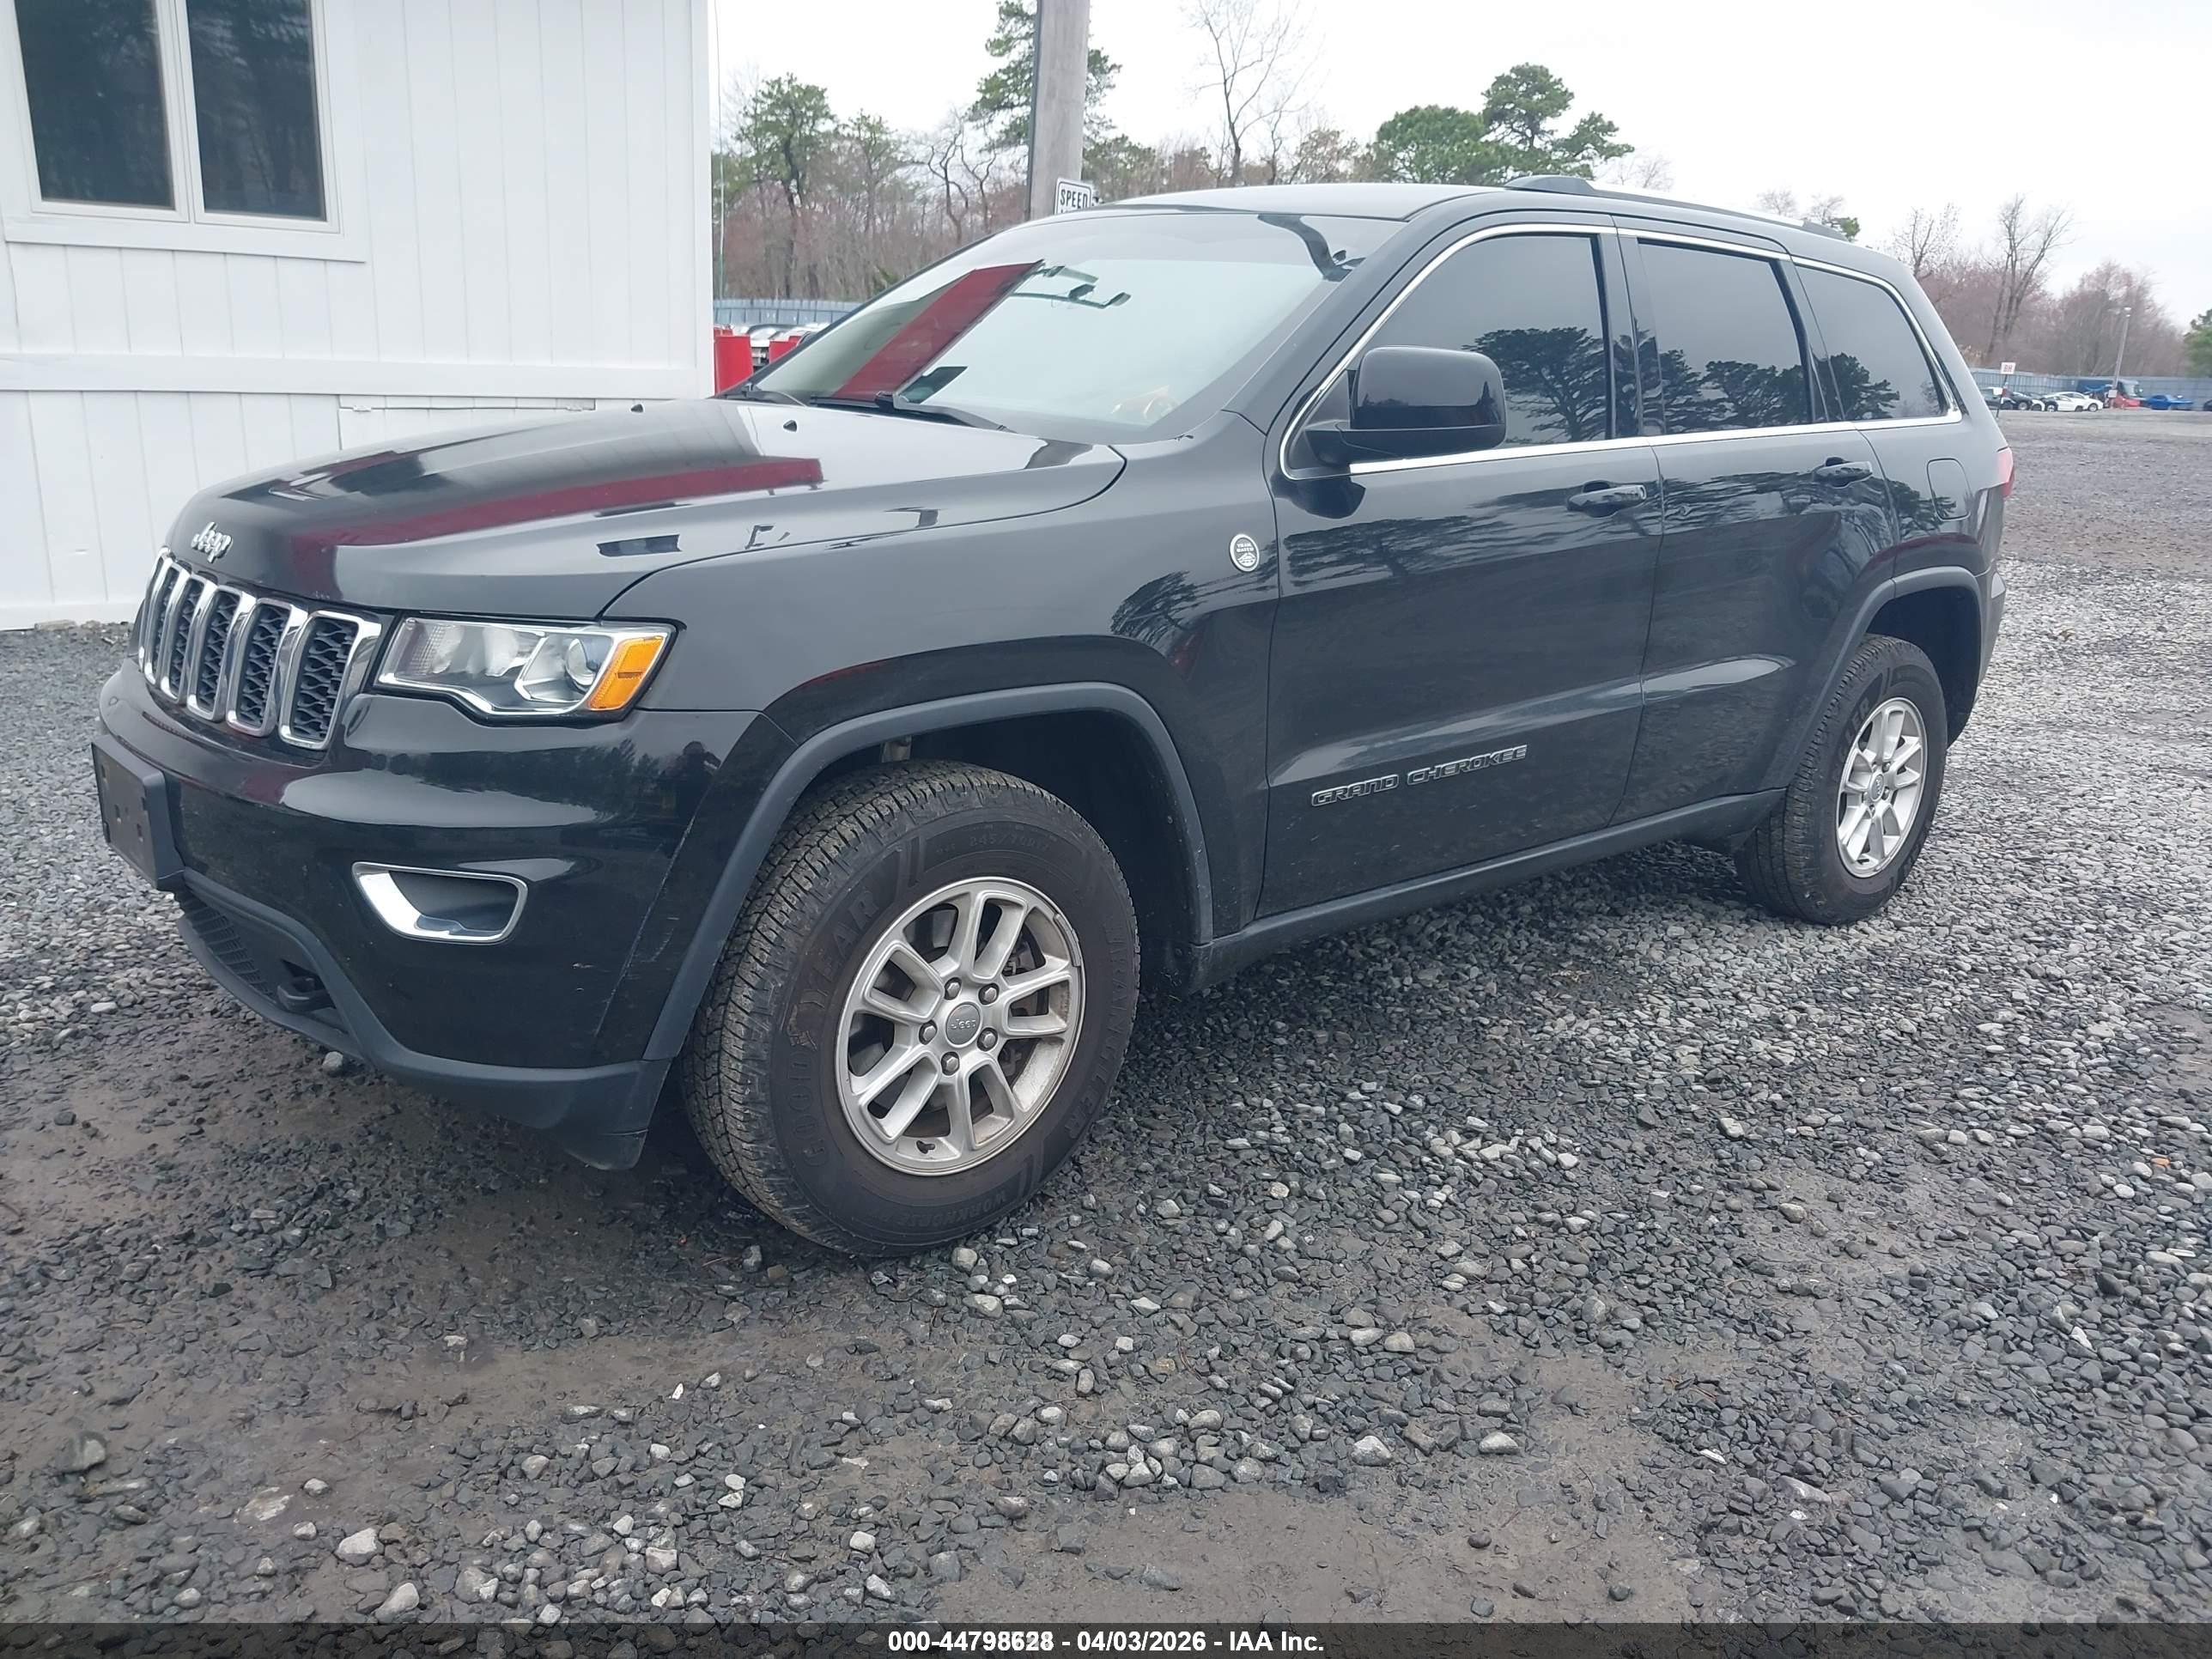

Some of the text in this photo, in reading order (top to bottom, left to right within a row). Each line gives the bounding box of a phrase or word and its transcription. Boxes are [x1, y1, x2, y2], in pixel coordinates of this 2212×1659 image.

[1060, 189, 1088, 209] SPEED
[191, 521, 232, 562] Jeep
[1311, 744, 1528, 806] GRAND CHEROKEE
